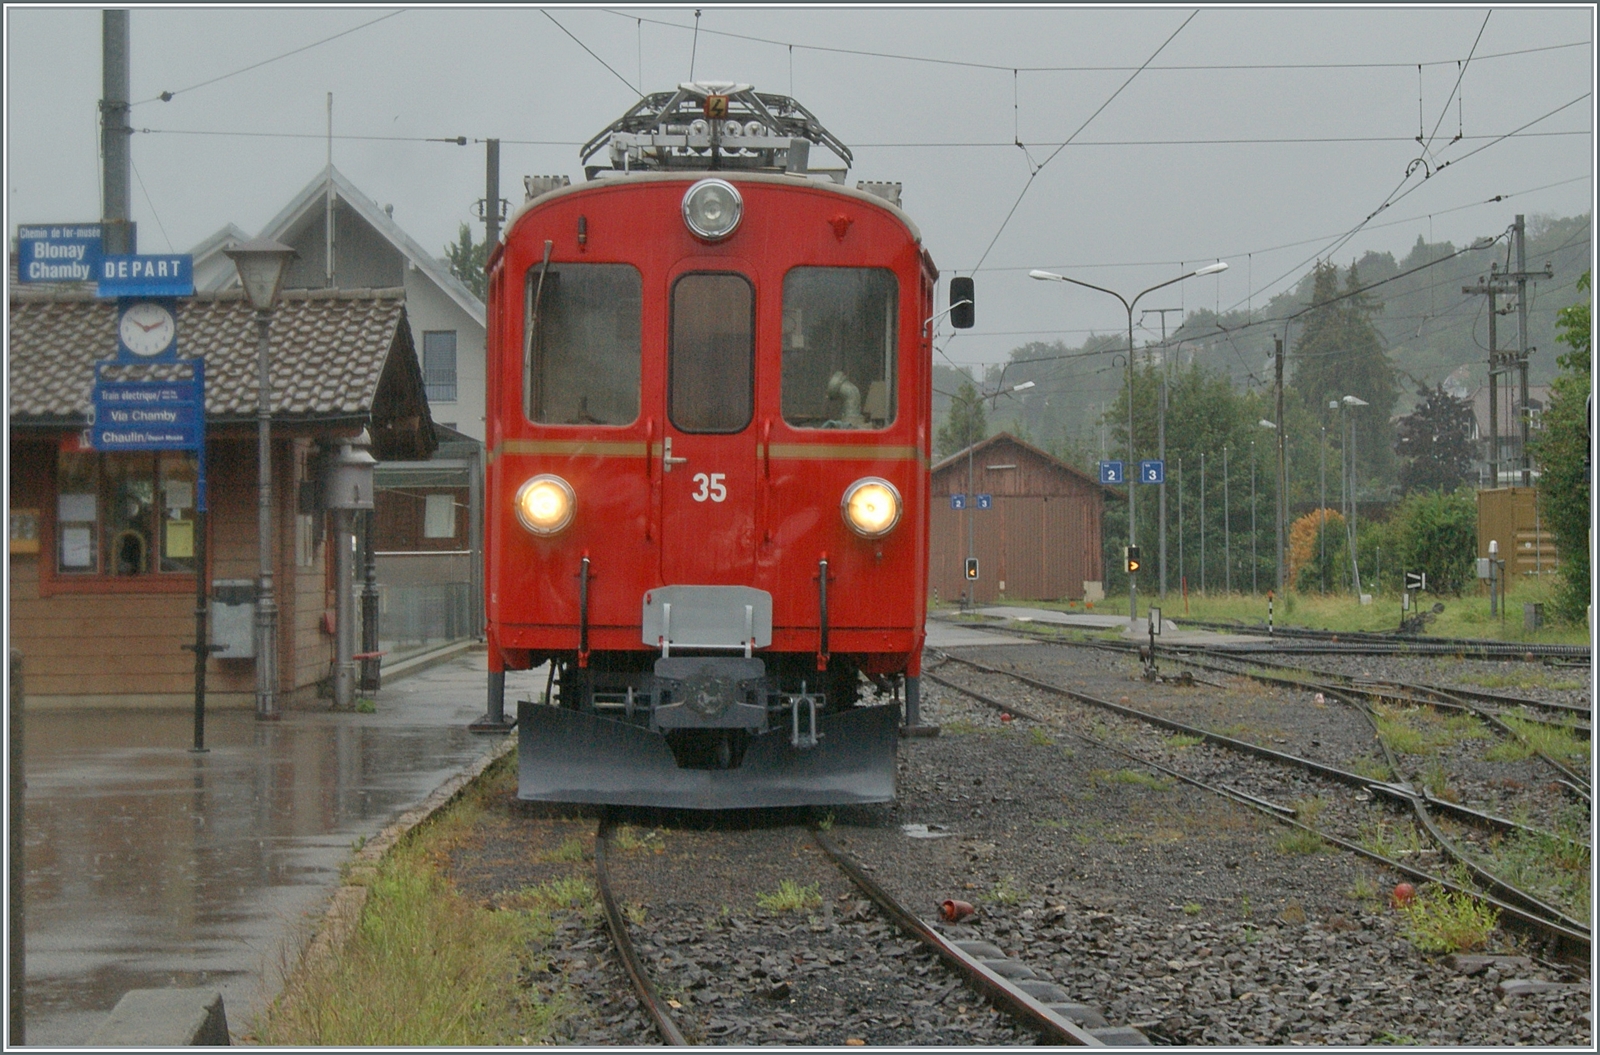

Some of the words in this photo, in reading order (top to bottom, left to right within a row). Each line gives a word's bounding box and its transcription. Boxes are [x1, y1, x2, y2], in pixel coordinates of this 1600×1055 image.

[20, 228, 47, 239] Chemin
[52, 227, 60, 238] de
[34, 242, 85, 260] Blonay
[29, 262, 90, 280] Chamby
[105, 261, 180, 278] DEPART
[102, 391, 119, 400] Train
[111, 411, 128, 421] Via
[132, 410, 176, 422] Chamby
[1107, 469, 1116, 481] 2
[1148, 469, 1157, 481] 3
[692, 473, 727, 502] 35
[955, 500, 961, 508] 2
[981, 500, 988, 508] 3
